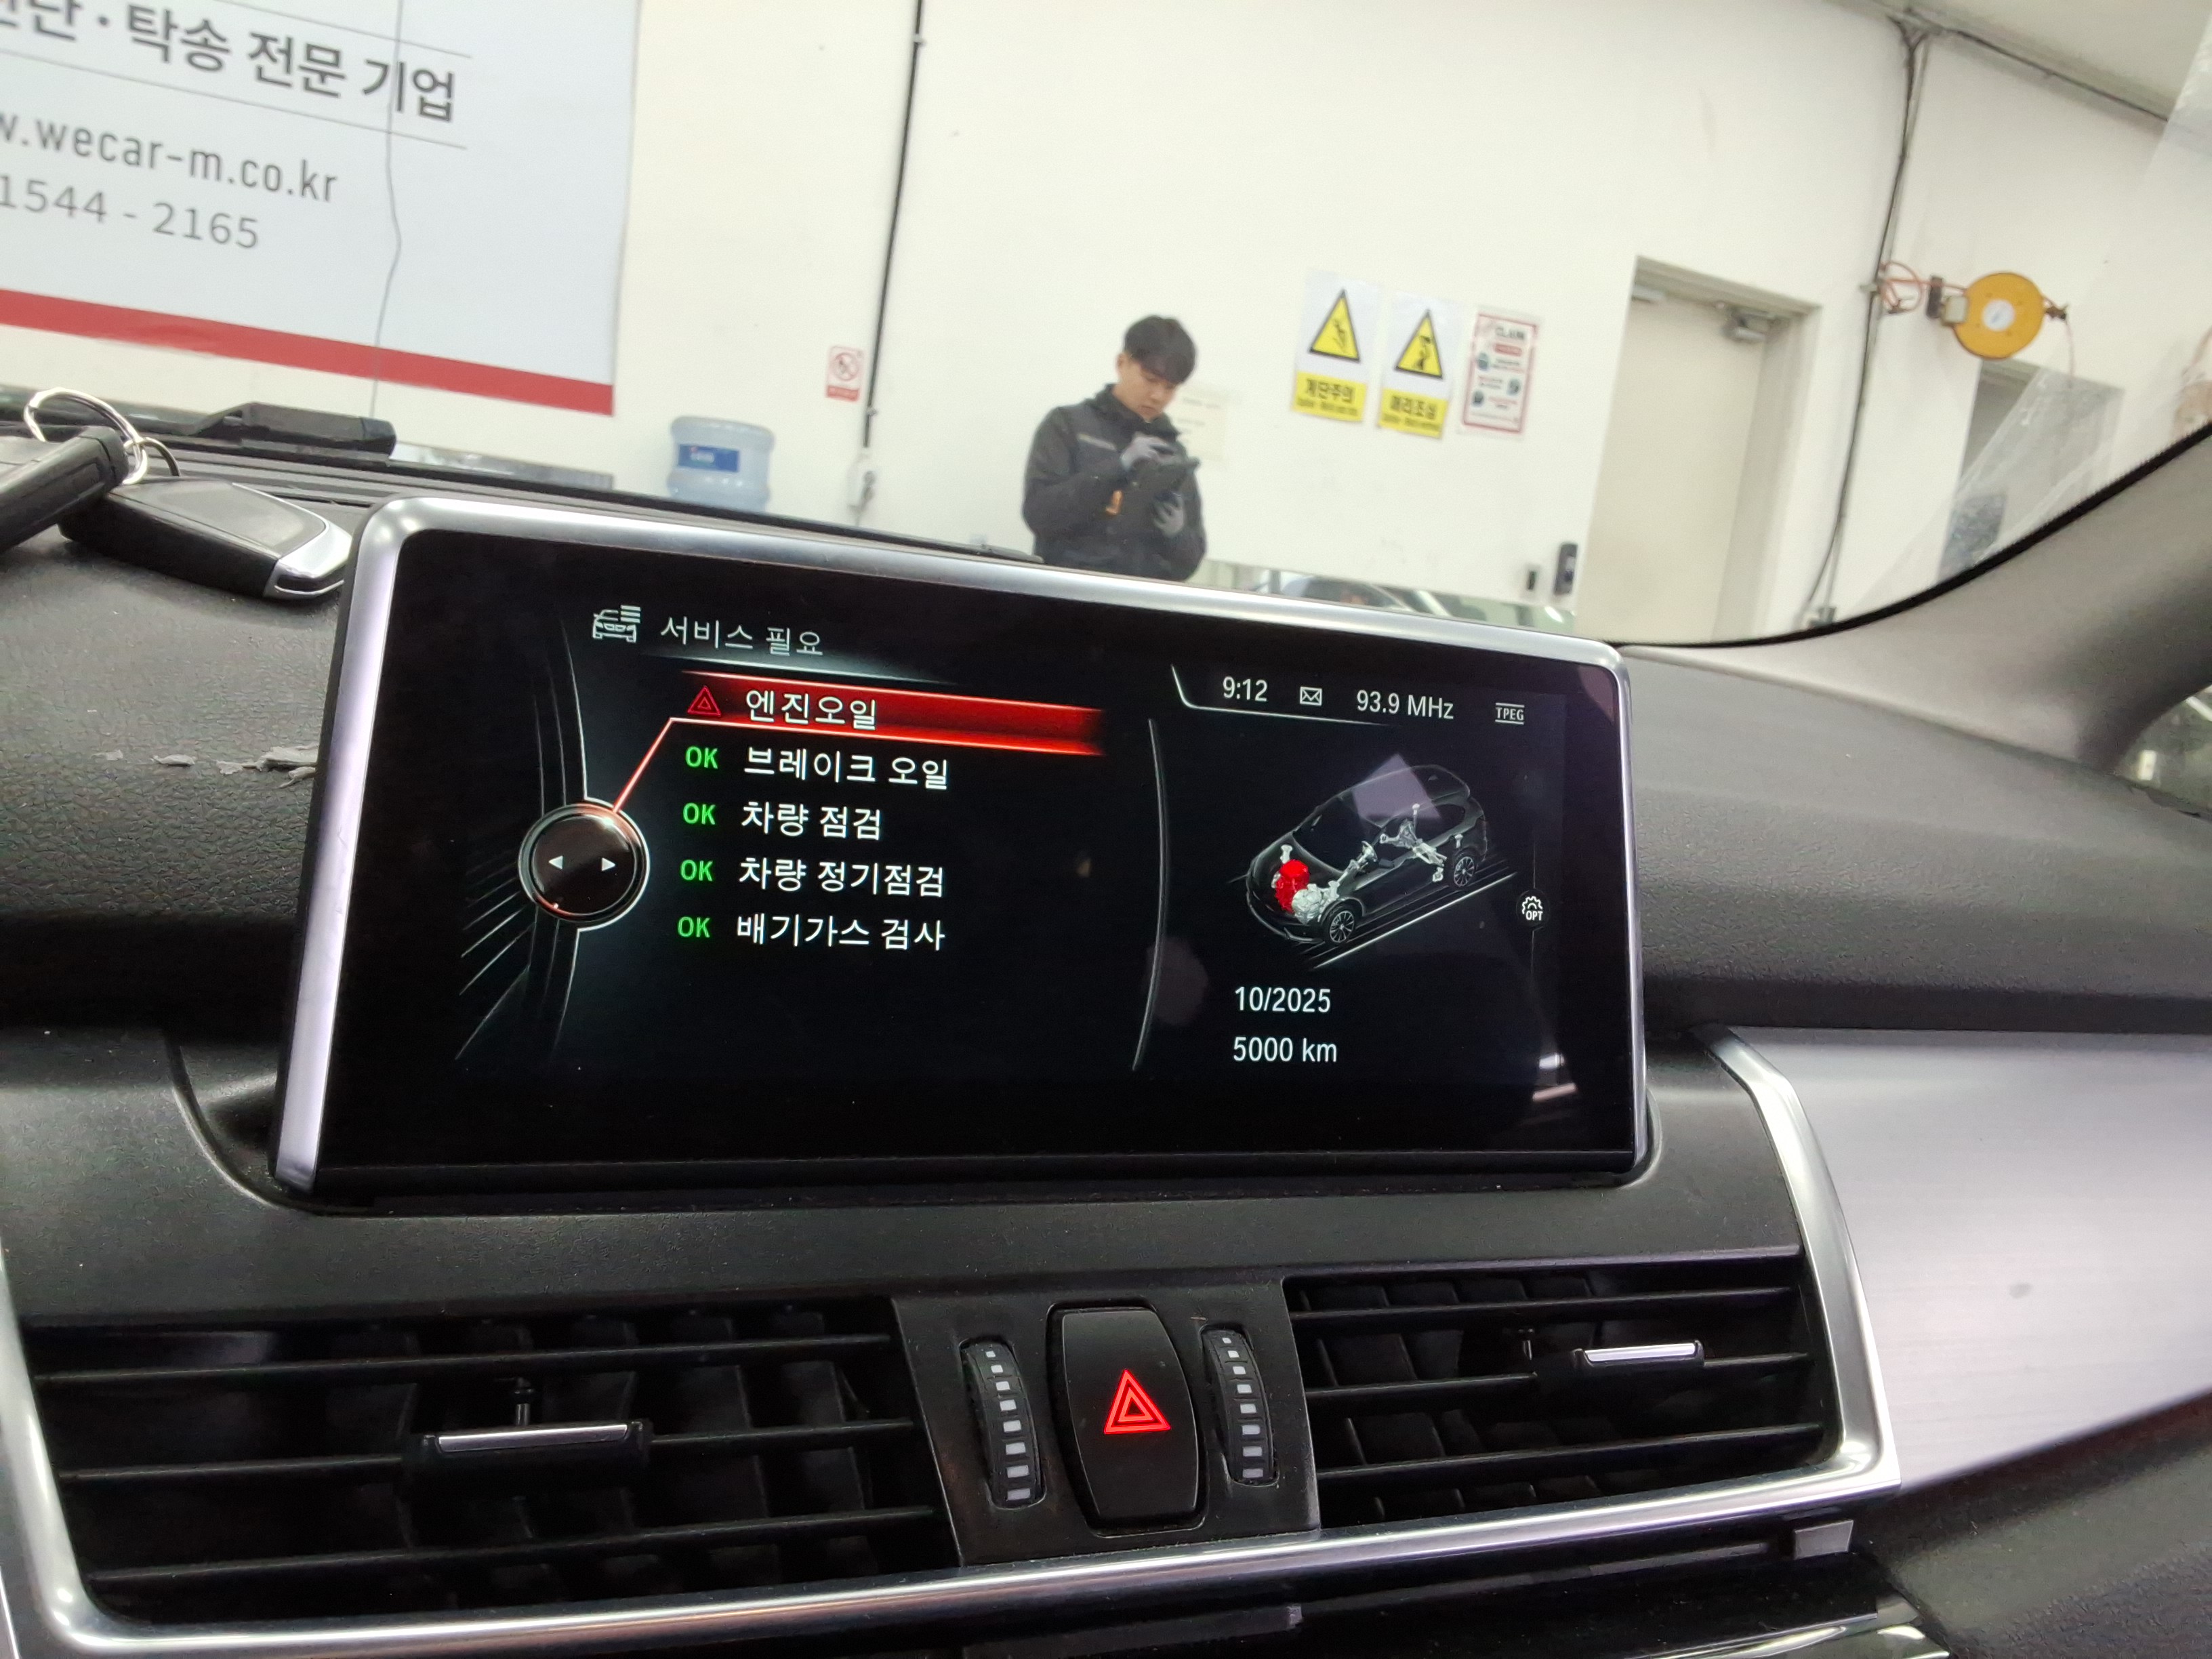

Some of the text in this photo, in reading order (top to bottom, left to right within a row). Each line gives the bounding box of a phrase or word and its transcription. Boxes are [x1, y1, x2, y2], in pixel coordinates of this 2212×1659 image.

[249, 32, 346, 98] 전문
[362, 60, 453, 122] 기업
[152, 203, 259, 250] 2165
[660, 615, 824, 657] 서비스 필요
[745, 689, 878, 731] 엔진오일
[1222, 676, 1454, 720] 9:12 93.9 MHz
[1495, 706, 1525, 721] TPEG
[685, 745, 948, 791] OK 브레이크 오일
[682, 800, 881, 841] OK 차량 점검
[680, 857, 944, 899] OK 차량 정기점검
[677, 913, 946, 951] OK 배기가스 검사
[1525, 909, 1543, 921] OPT
[1234, 986, 1331, 1013] 10/2025
[1233, 1036, 1338, 1063] 5000 km
